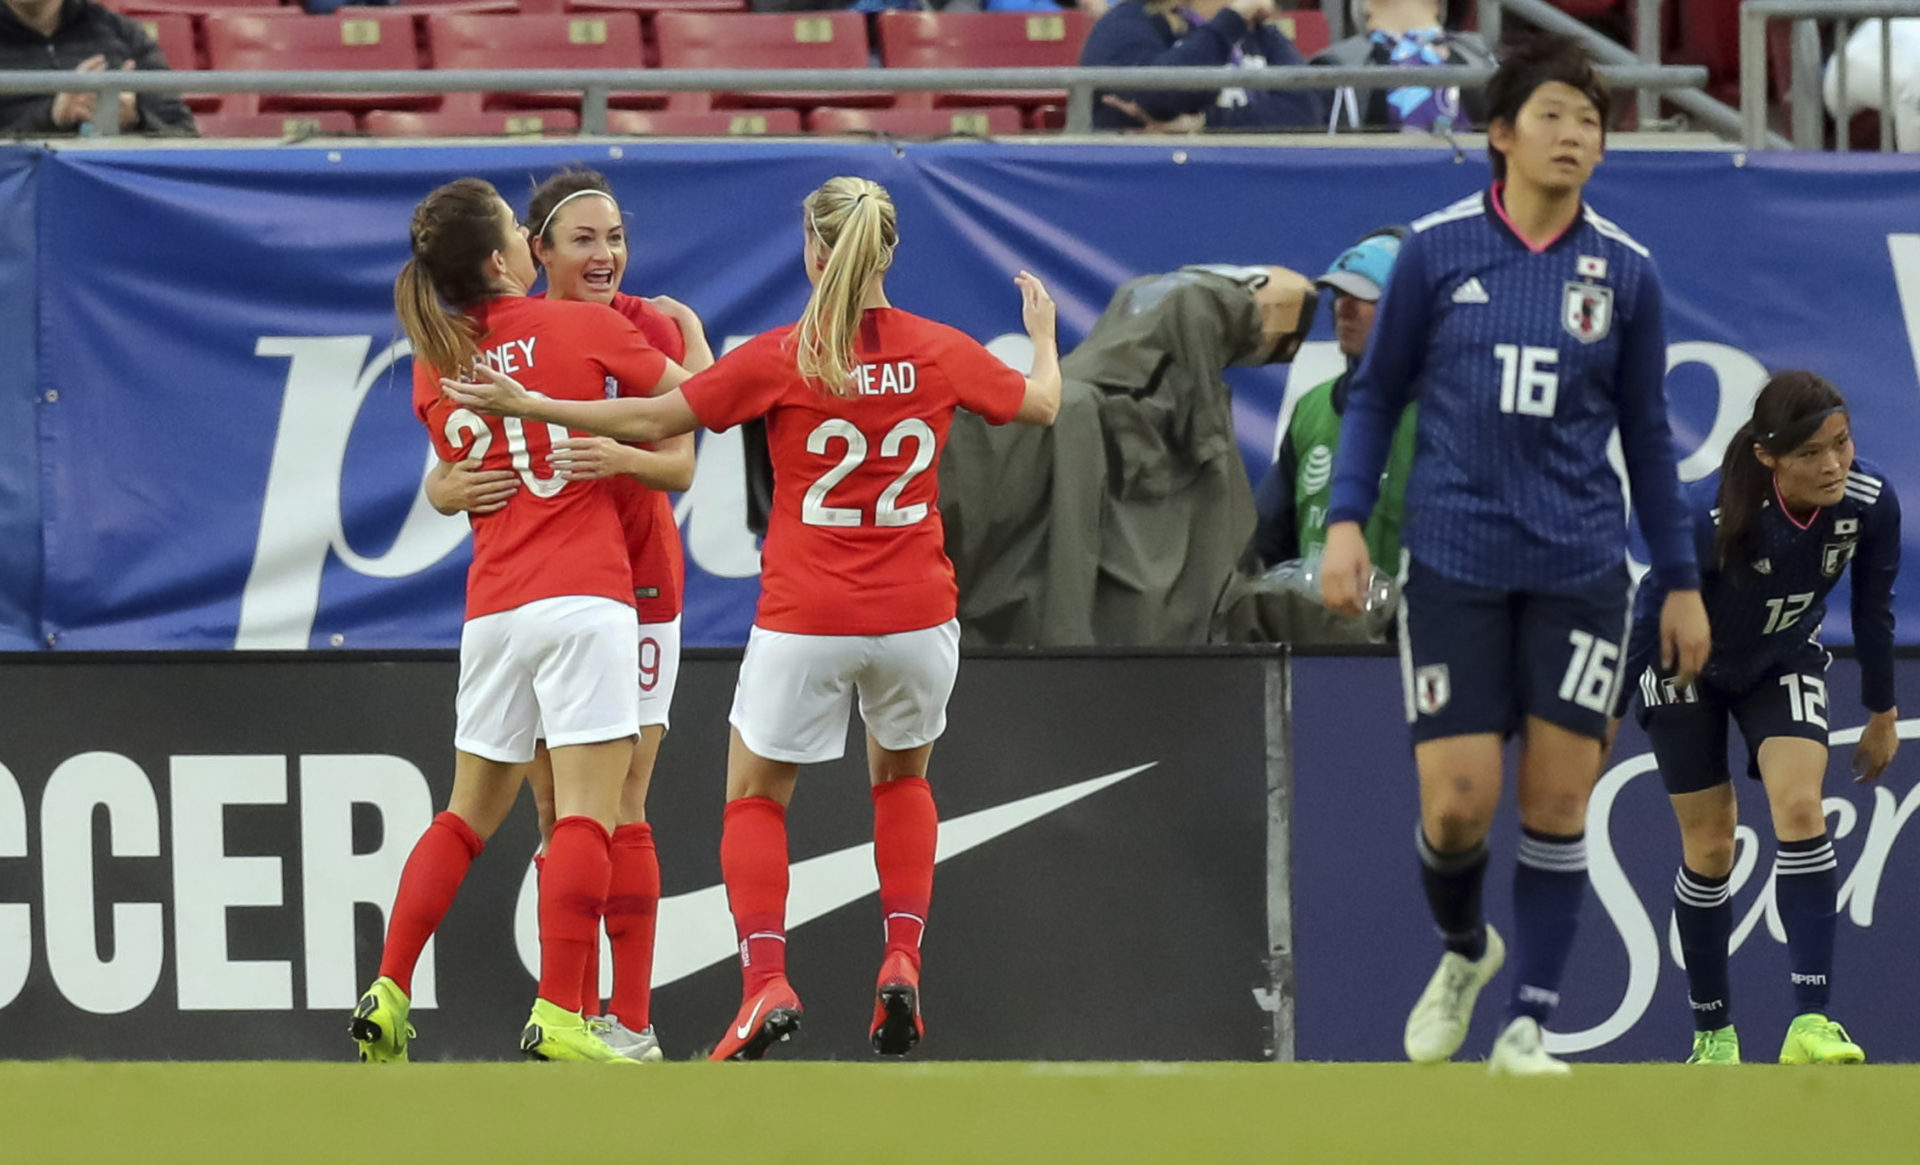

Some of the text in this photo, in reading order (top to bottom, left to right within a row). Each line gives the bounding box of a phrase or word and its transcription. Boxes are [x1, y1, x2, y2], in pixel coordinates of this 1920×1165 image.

[1494, 343, 1559, 418] 16
[802, 417, 937, 527] 22
[1762, 592, 1815, 634] 12
[638, 636, 660, 692] 9
[1558, 629, 1620, 715] 16
[1779, 672, 1829, 731] 12
[0, 751, 440, 1014] CER
